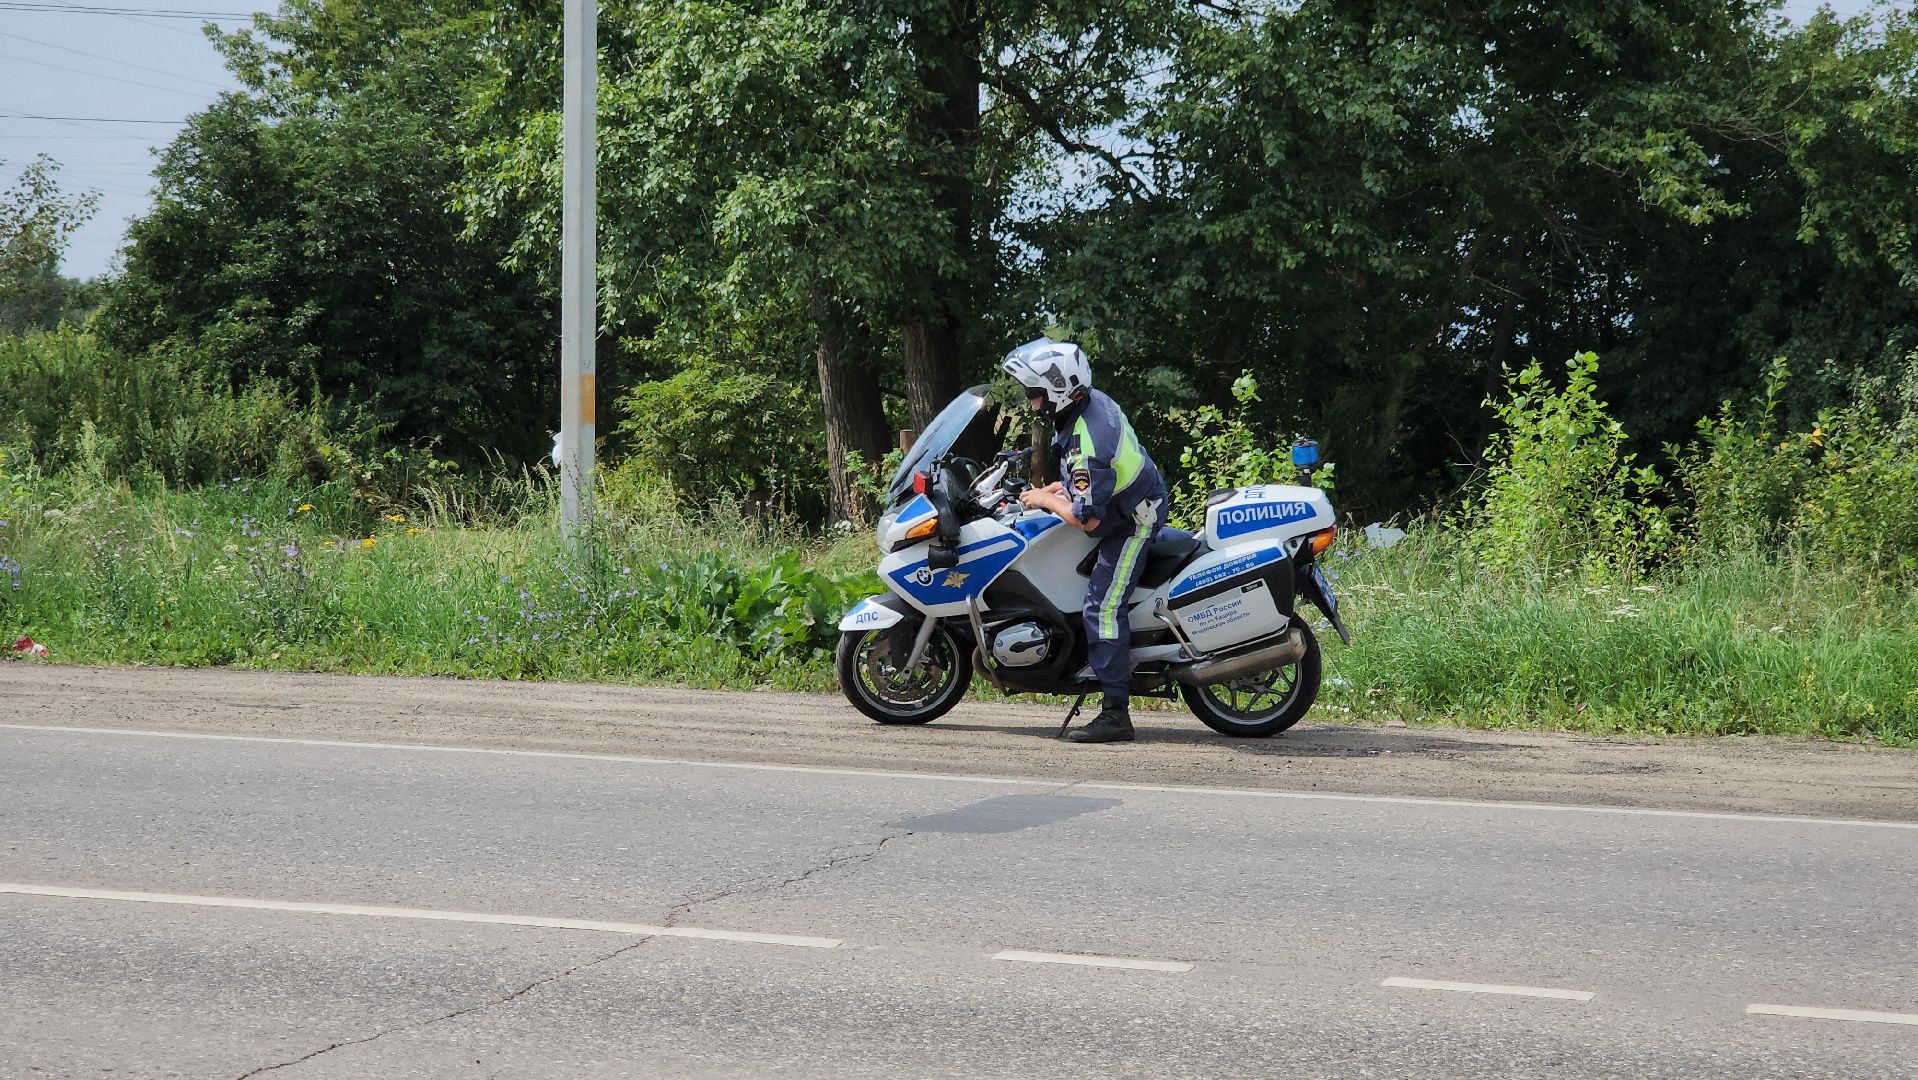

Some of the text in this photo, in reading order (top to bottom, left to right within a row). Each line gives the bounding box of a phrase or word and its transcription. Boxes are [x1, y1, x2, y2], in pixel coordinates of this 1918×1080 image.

[1219, 502, 1307, 526] ПОЛИЦИЯ
[1188, 553, 1257, 581] ТЕЛЕФОН ДОВЕРИЯ
[855, 611, 878, 624] ДПС
[1187, 599, 1242, 623] ОМВД России
